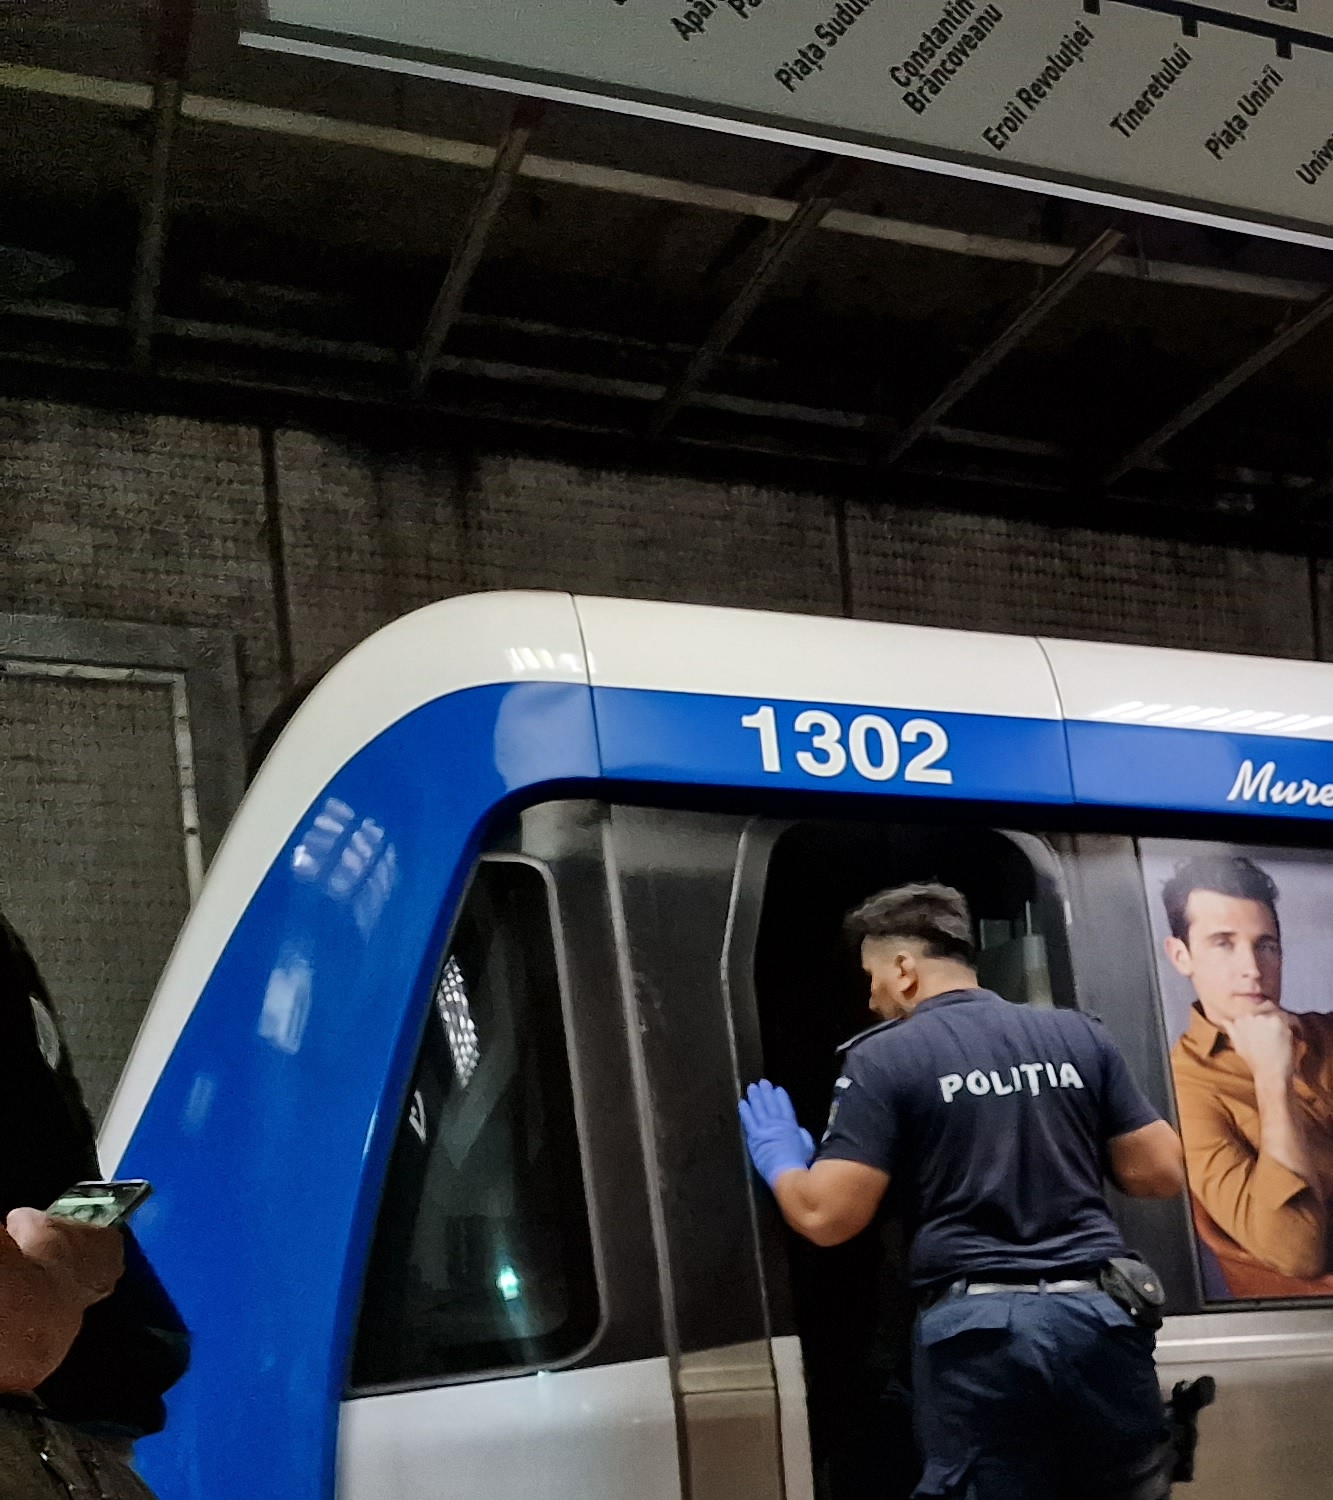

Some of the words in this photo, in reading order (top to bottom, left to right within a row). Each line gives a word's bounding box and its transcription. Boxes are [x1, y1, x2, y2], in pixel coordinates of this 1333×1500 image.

[774, 42, 827, 93] Piața
[902, 3, 1003, 114] Brâncoveanu
[981, 100, 1029, 151] Eroii
[1015, 20, 1095, 112] Revoluției
[1109, 42, 1193, 137] Tineretului
[1204, 114, 1250, 160] Piața
[1237, 64, 1285, 117] Unirii
[741, 705, 953, 784] 1302
